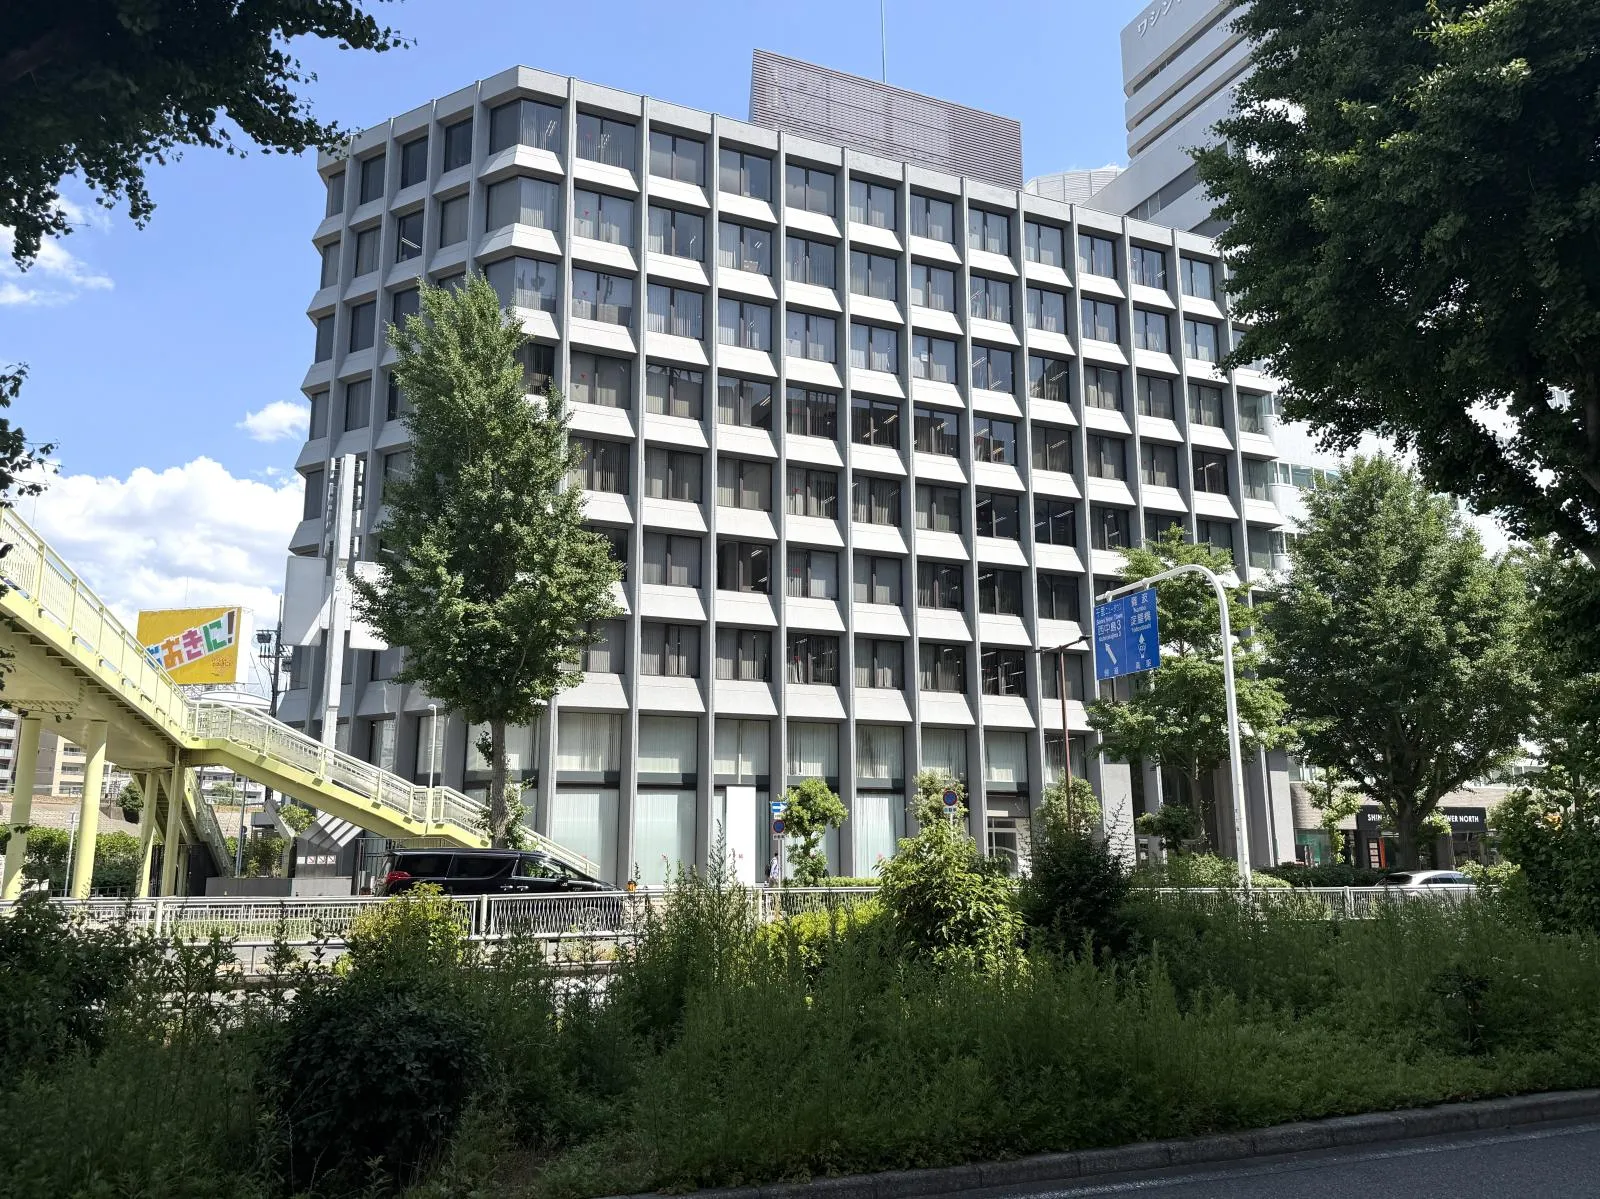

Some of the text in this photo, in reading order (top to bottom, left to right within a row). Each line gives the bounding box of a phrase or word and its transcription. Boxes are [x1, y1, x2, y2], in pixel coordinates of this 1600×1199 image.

[1137, 0, 1182, 40] ワシン
[1459, 815, 1479, 823] NORTH
